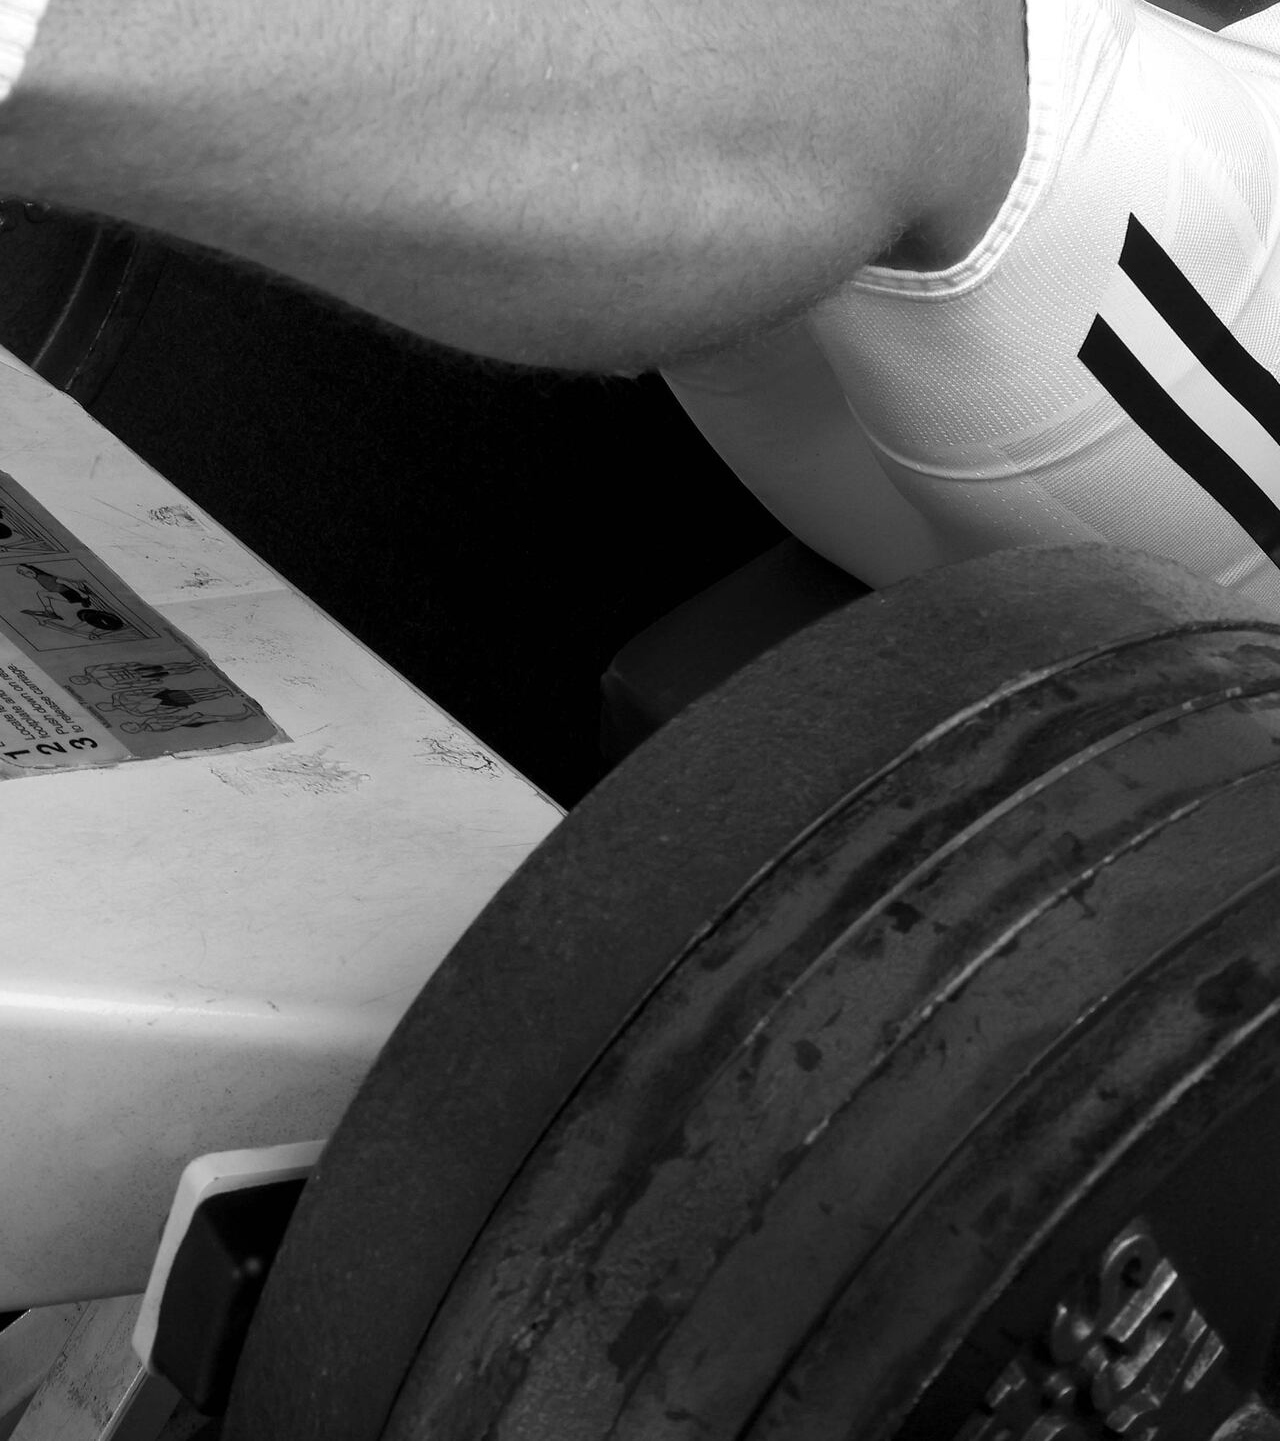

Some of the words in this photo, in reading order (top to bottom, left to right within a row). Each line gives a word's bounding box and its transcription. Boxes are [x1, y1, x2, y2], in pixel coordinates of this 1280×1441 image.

[8, 682, 23, 691] on
[21, 693, 47, 713] down
[40, 696, 74, 723] release
[3, 714, 36, 740] Locate
[12, 706, 51, 738] footplate
[43, 715, 69, 734] Push
[72, 725, 84, 733] to
[36, 742, 67, 755] 2
[69, 738, 98, 749] 3
[3, 750, 30, 759] 1
